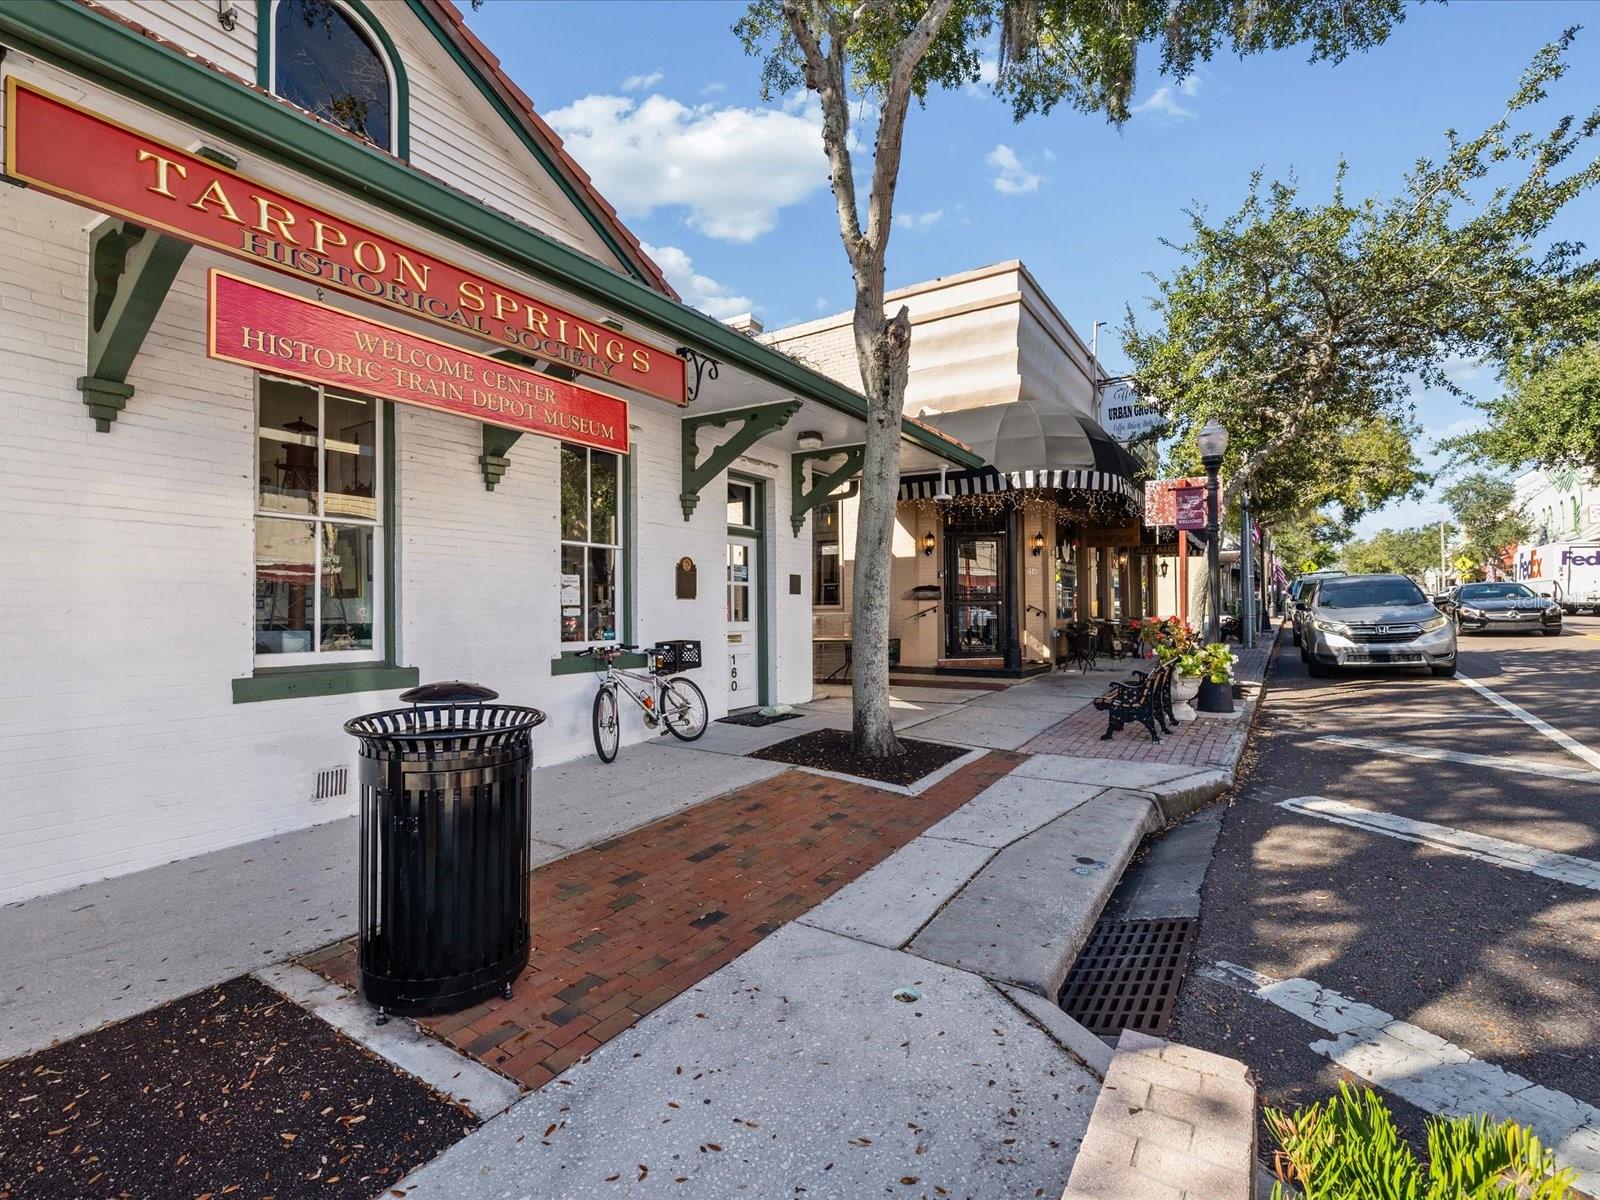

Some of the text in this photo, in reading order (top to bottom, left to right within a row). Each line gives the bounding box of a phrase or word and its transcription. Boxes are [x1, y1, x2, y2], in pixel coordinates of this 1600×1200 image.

[137, 149, 650, 373] TARPON SPRINGS
[240, 229, 614, 377] HISTORICAL SOCIETY
[242, 326, 615, 440] HISTORIC TRAIN DEPOT MUSEUM
[354, 330, 556, 404] WELCOME CENTER
[1108, 405, 1132, 421] URBAN
[1519, 549, 1542, 580] FedEx
[1561, 550, 1600, 566] Fed
